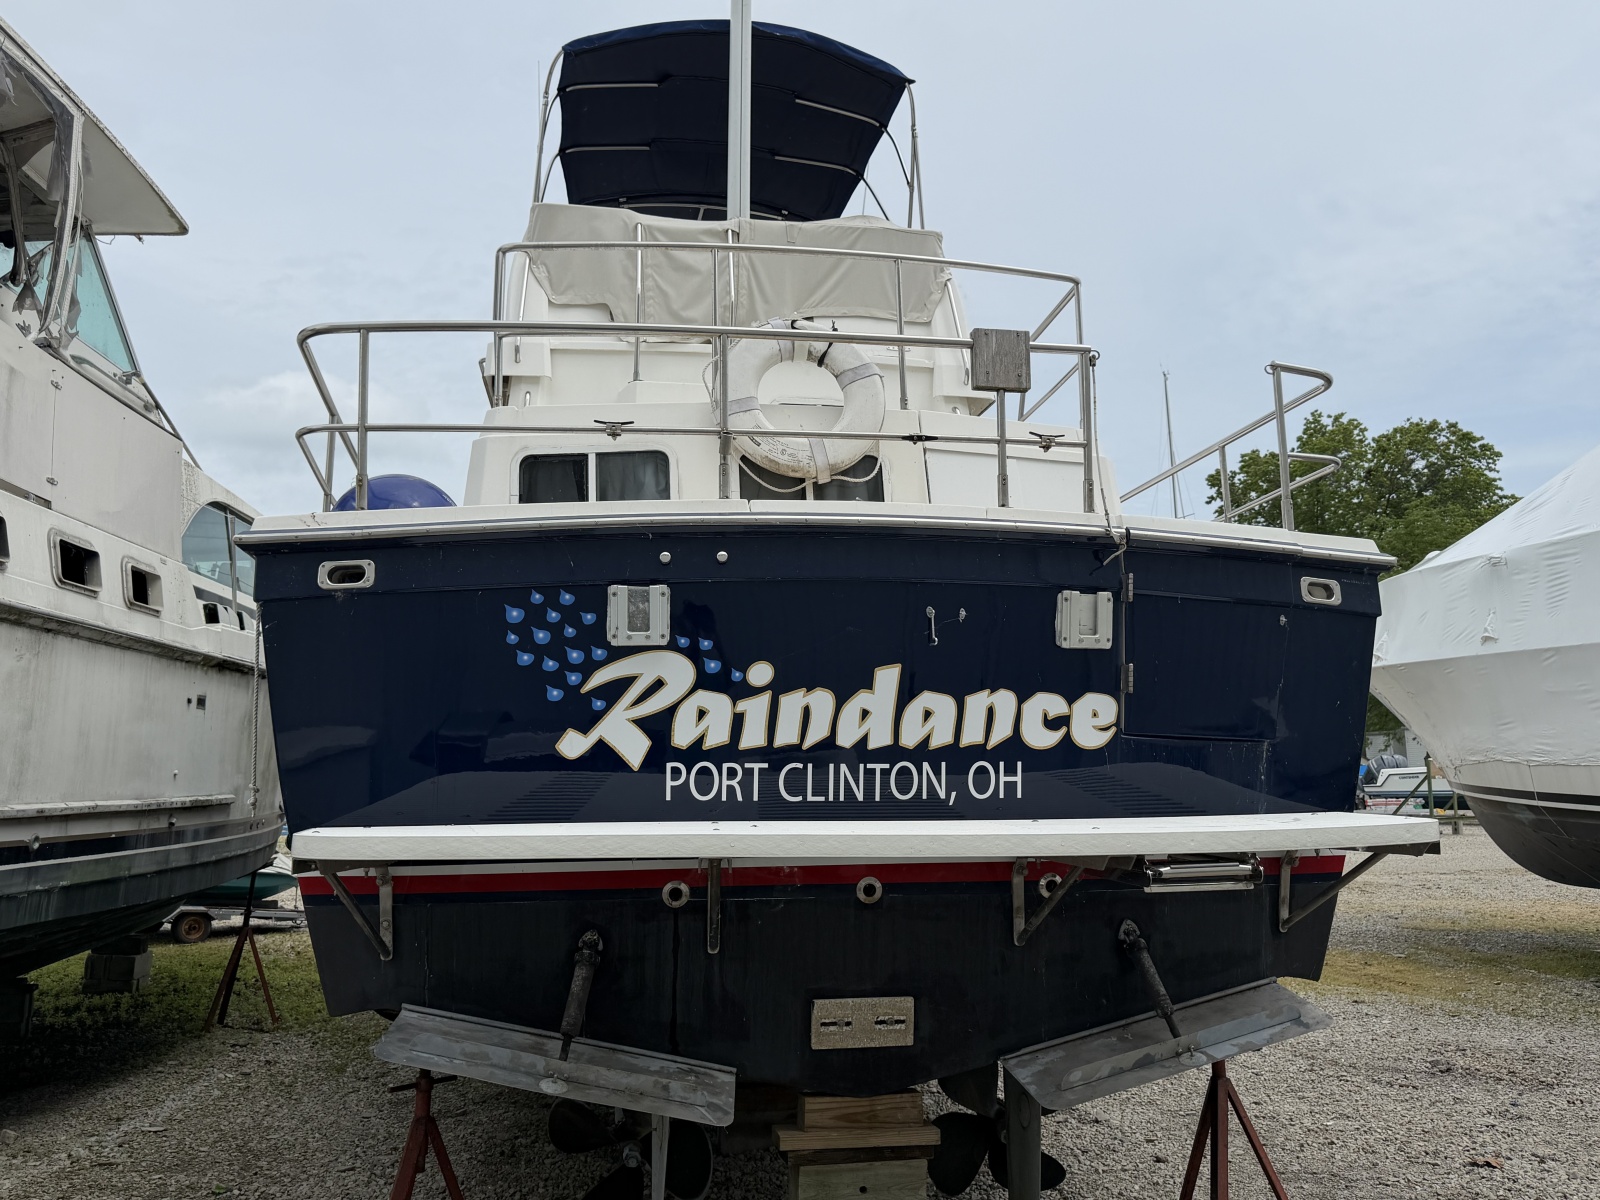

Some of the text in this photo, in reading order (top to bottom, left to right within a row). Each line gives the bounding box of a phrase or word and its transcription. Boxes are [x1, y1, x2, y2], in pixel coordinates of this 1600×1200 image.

[555, 651, 1118, 771] Raindance
[665, 760, 1022, 806] PORT CLINTON, OH
